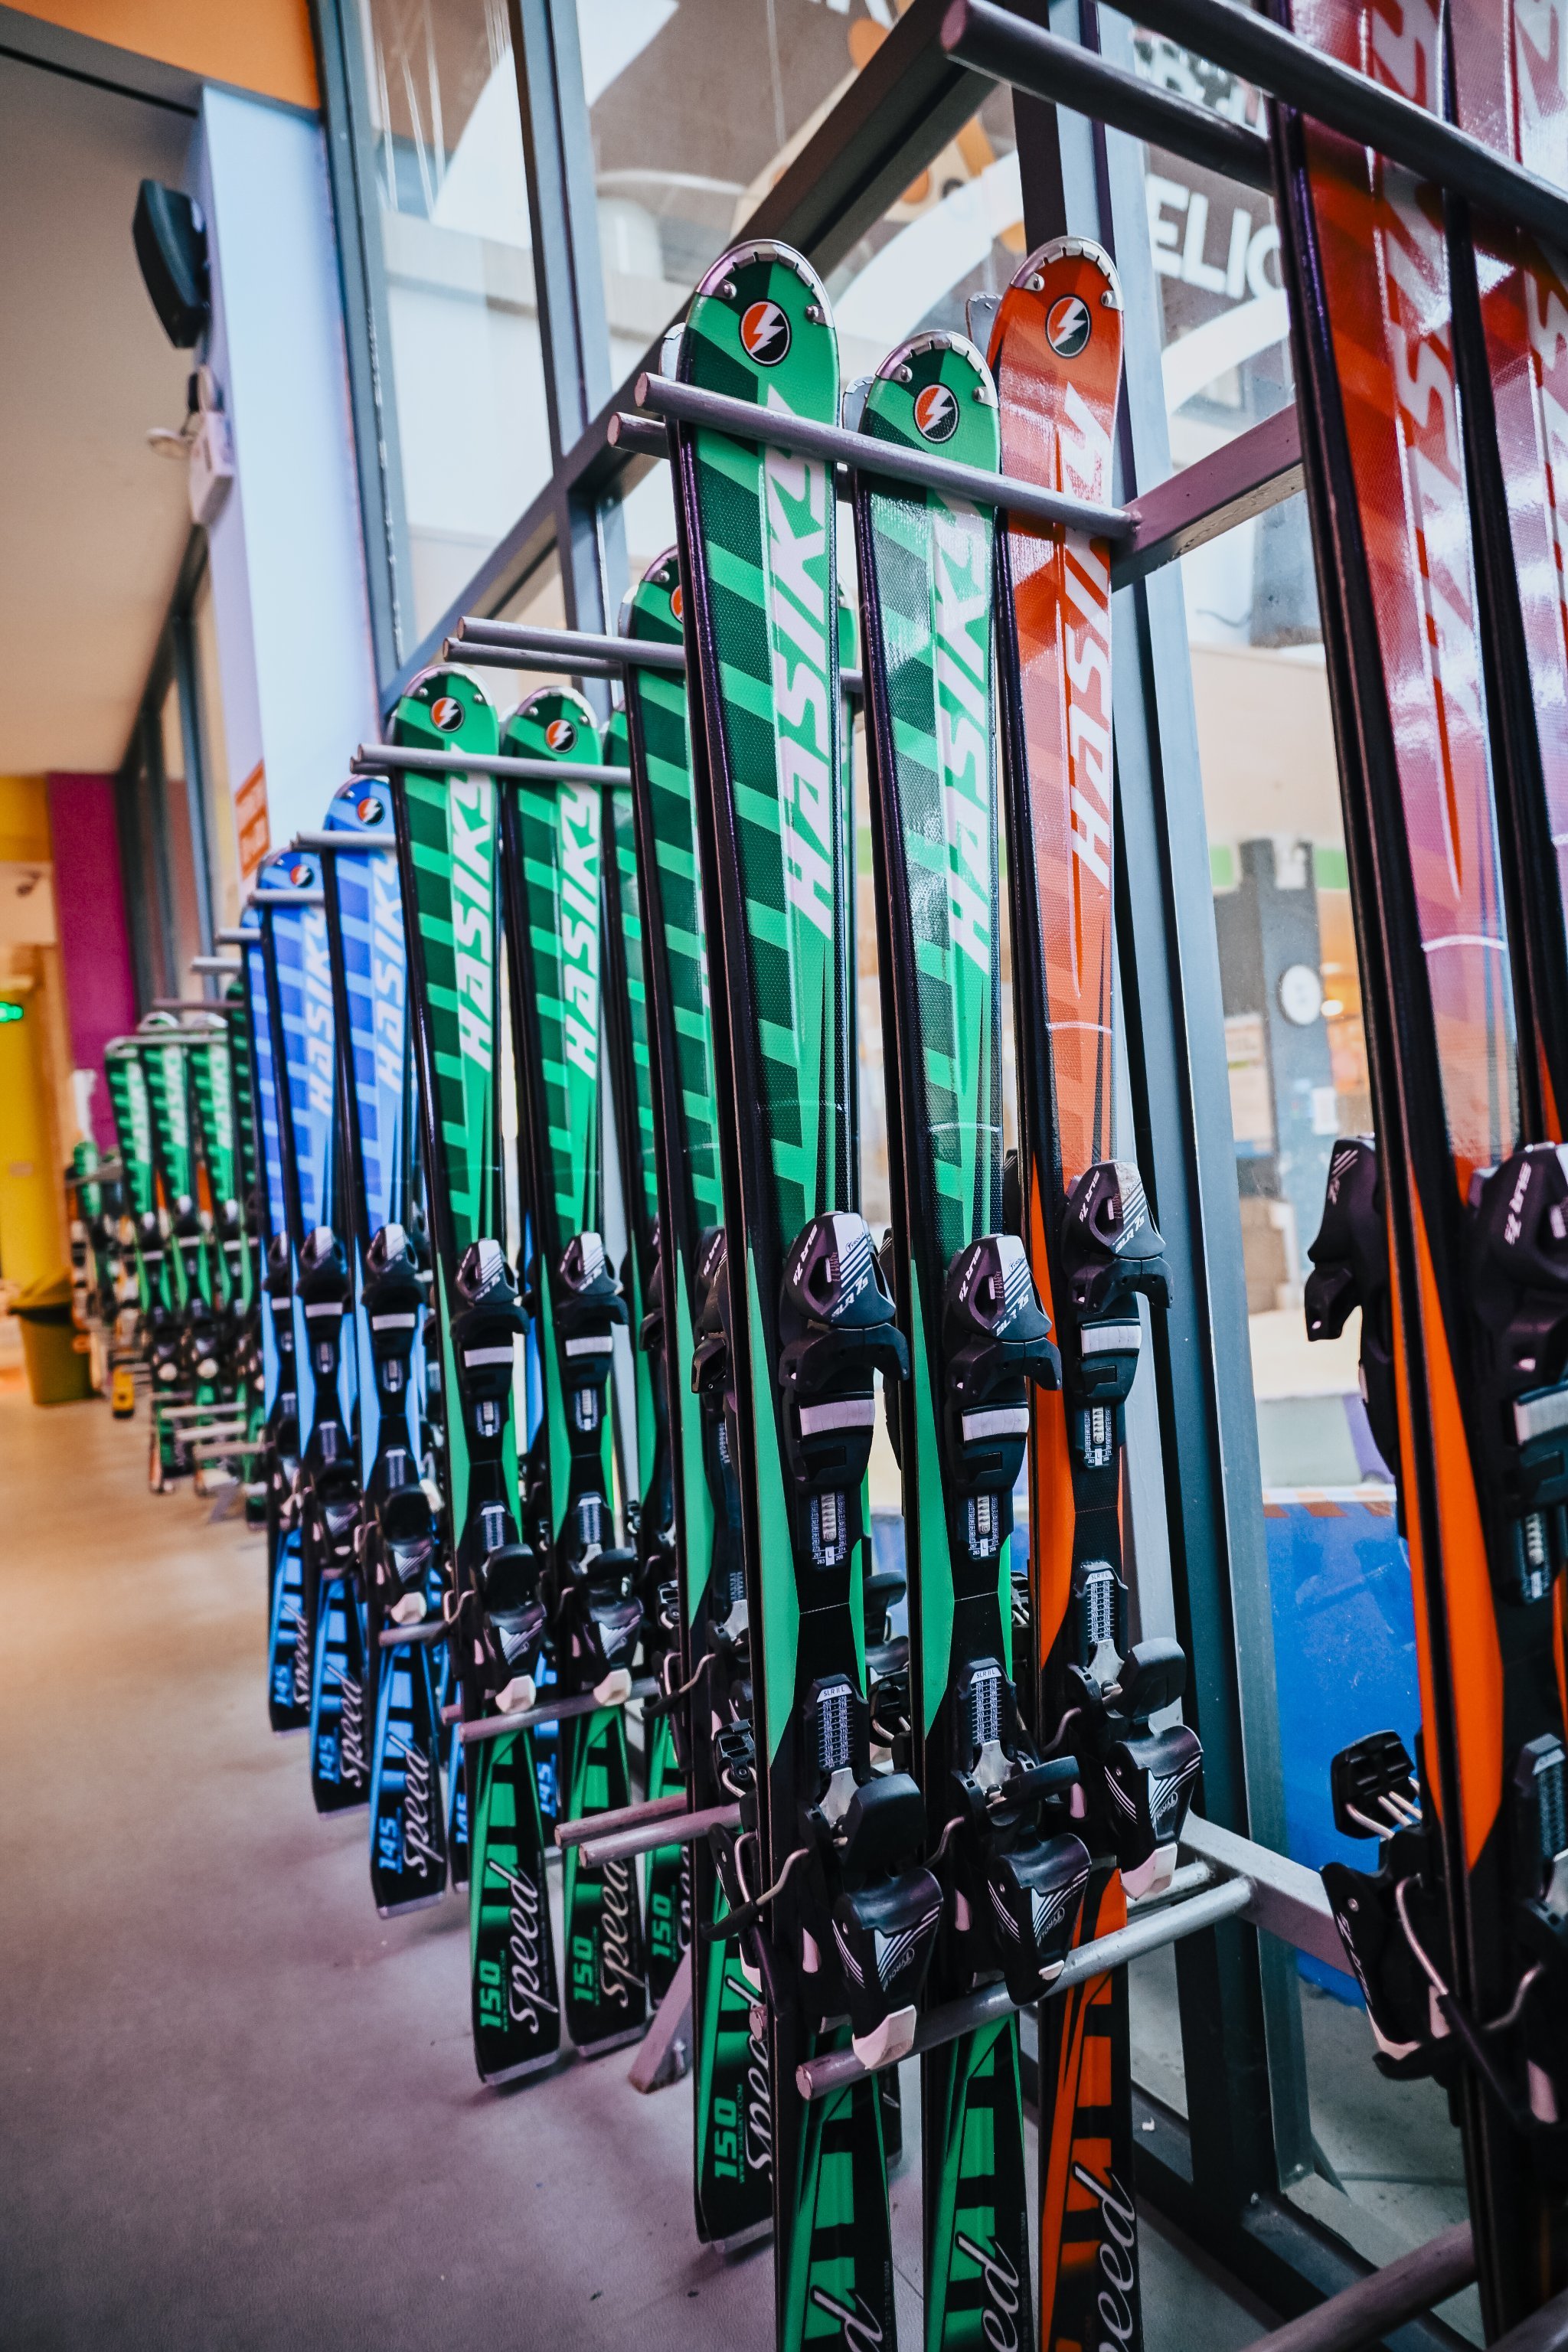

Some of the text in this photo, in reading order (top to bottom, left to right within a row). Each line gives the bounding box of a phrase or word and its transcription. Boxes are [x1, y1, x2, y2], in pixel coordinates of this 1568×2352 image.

[326, 1664, 371, 1788] Speed
[379, 1815, 397, 1871] 145
[389, 1734, 444, 1878] Speed
[489, 1860, 559, 2034] Speed
[652, 1893, 672, 1957] 150
[479, 1959, 501, 2028] 150
[573, 1936, 594, 2002] 150
[714, 2096, 738, 2179] 150
